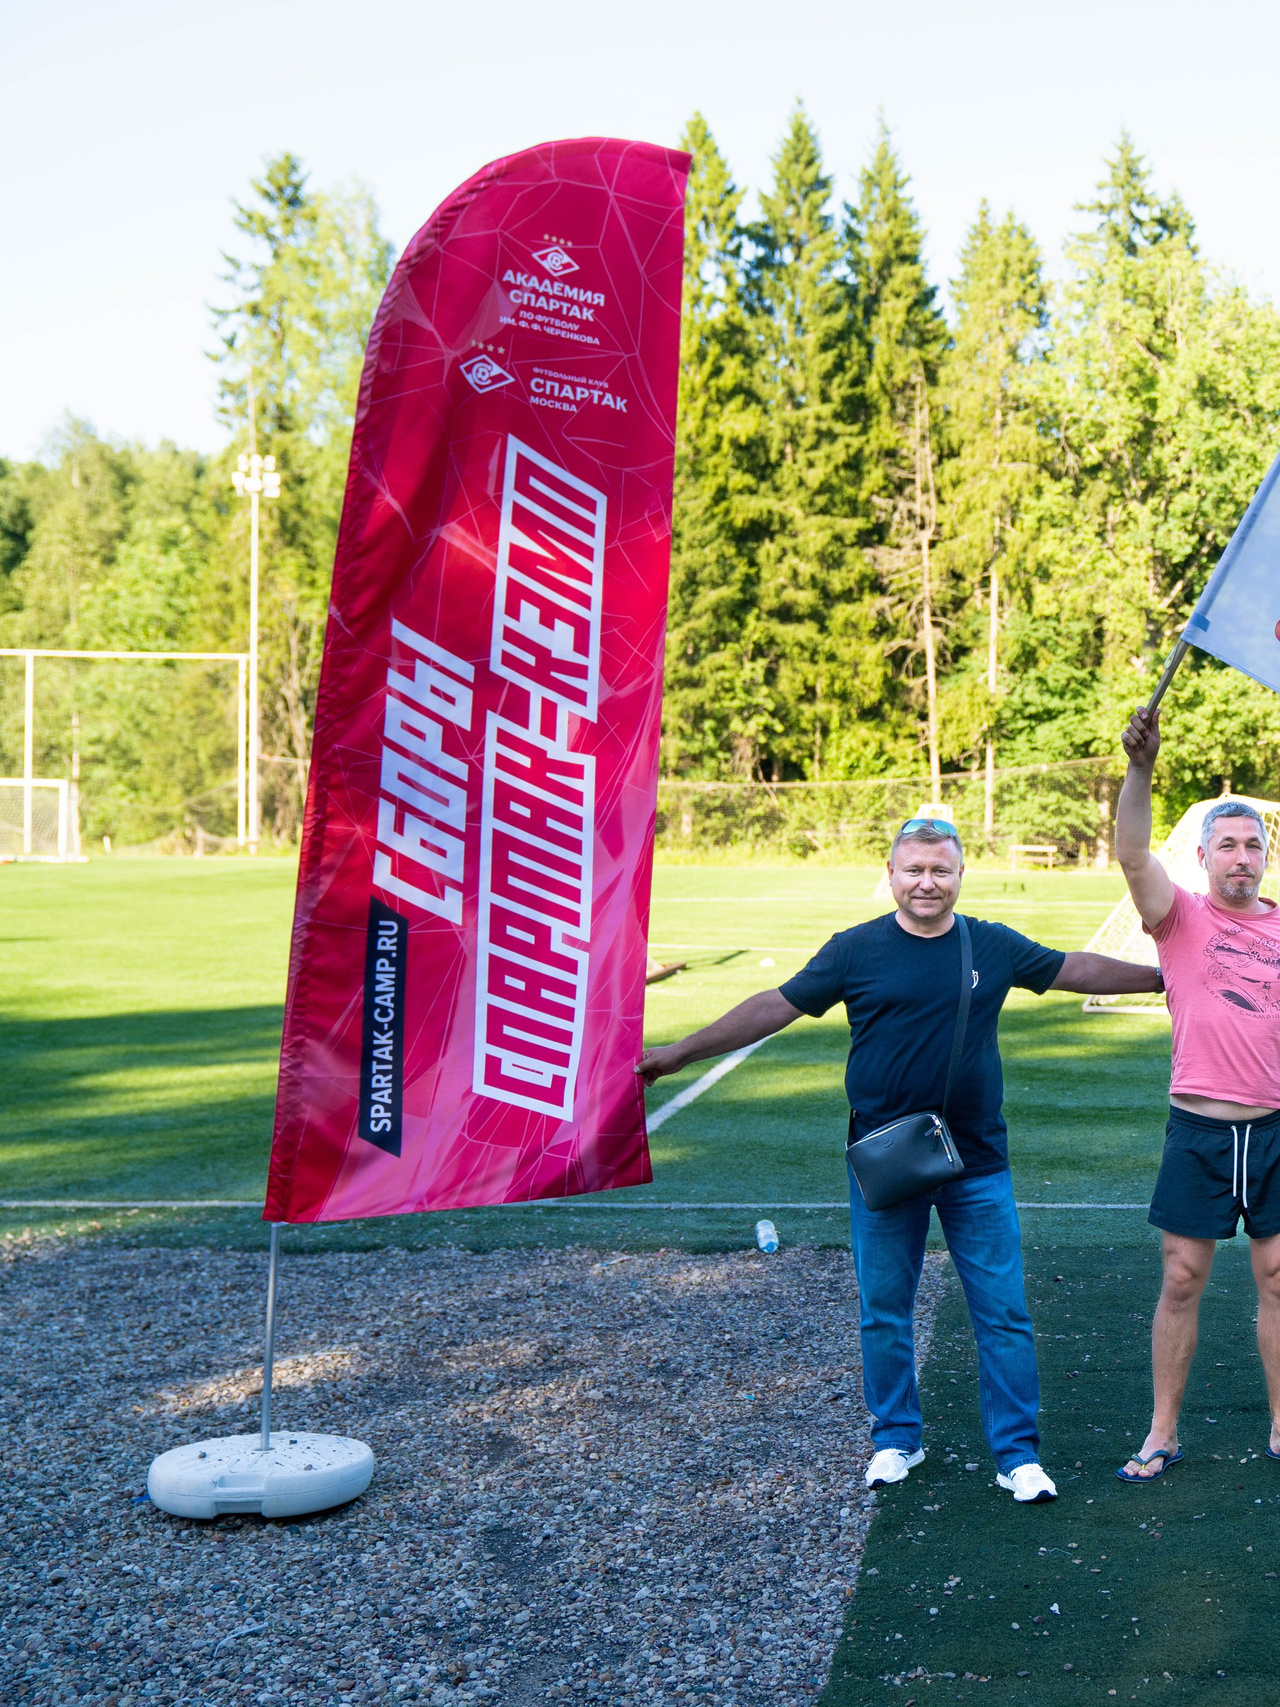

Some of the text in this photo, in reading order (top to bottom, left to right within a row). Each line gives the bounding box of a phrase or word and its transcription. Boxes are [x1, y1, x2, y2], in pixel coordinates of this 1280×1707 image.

[502, 269, 605, 306] АКАДЕМИЯ
[509, 290, 595, 322] СПАРТАК
[519, 310, 580, 331] ПО ФУТБОЛУ
[500, 316, 600, 345] ИМ. Ф. Ф. ЧЕРЕНКОВА
[532, 366, 609, 389] ФУТБОЛЬНЫЙ КЛУБ
[530, 377, 628, 413] СПАРТАК
[530, 396, 578, 413] МОСКВА
[373, 617, 475, 925] СБОРЫ
[1202, 980, 1236, 1011] SURFING
[369, 918, 400, 1133] SPARTAK-CAMP.RU
